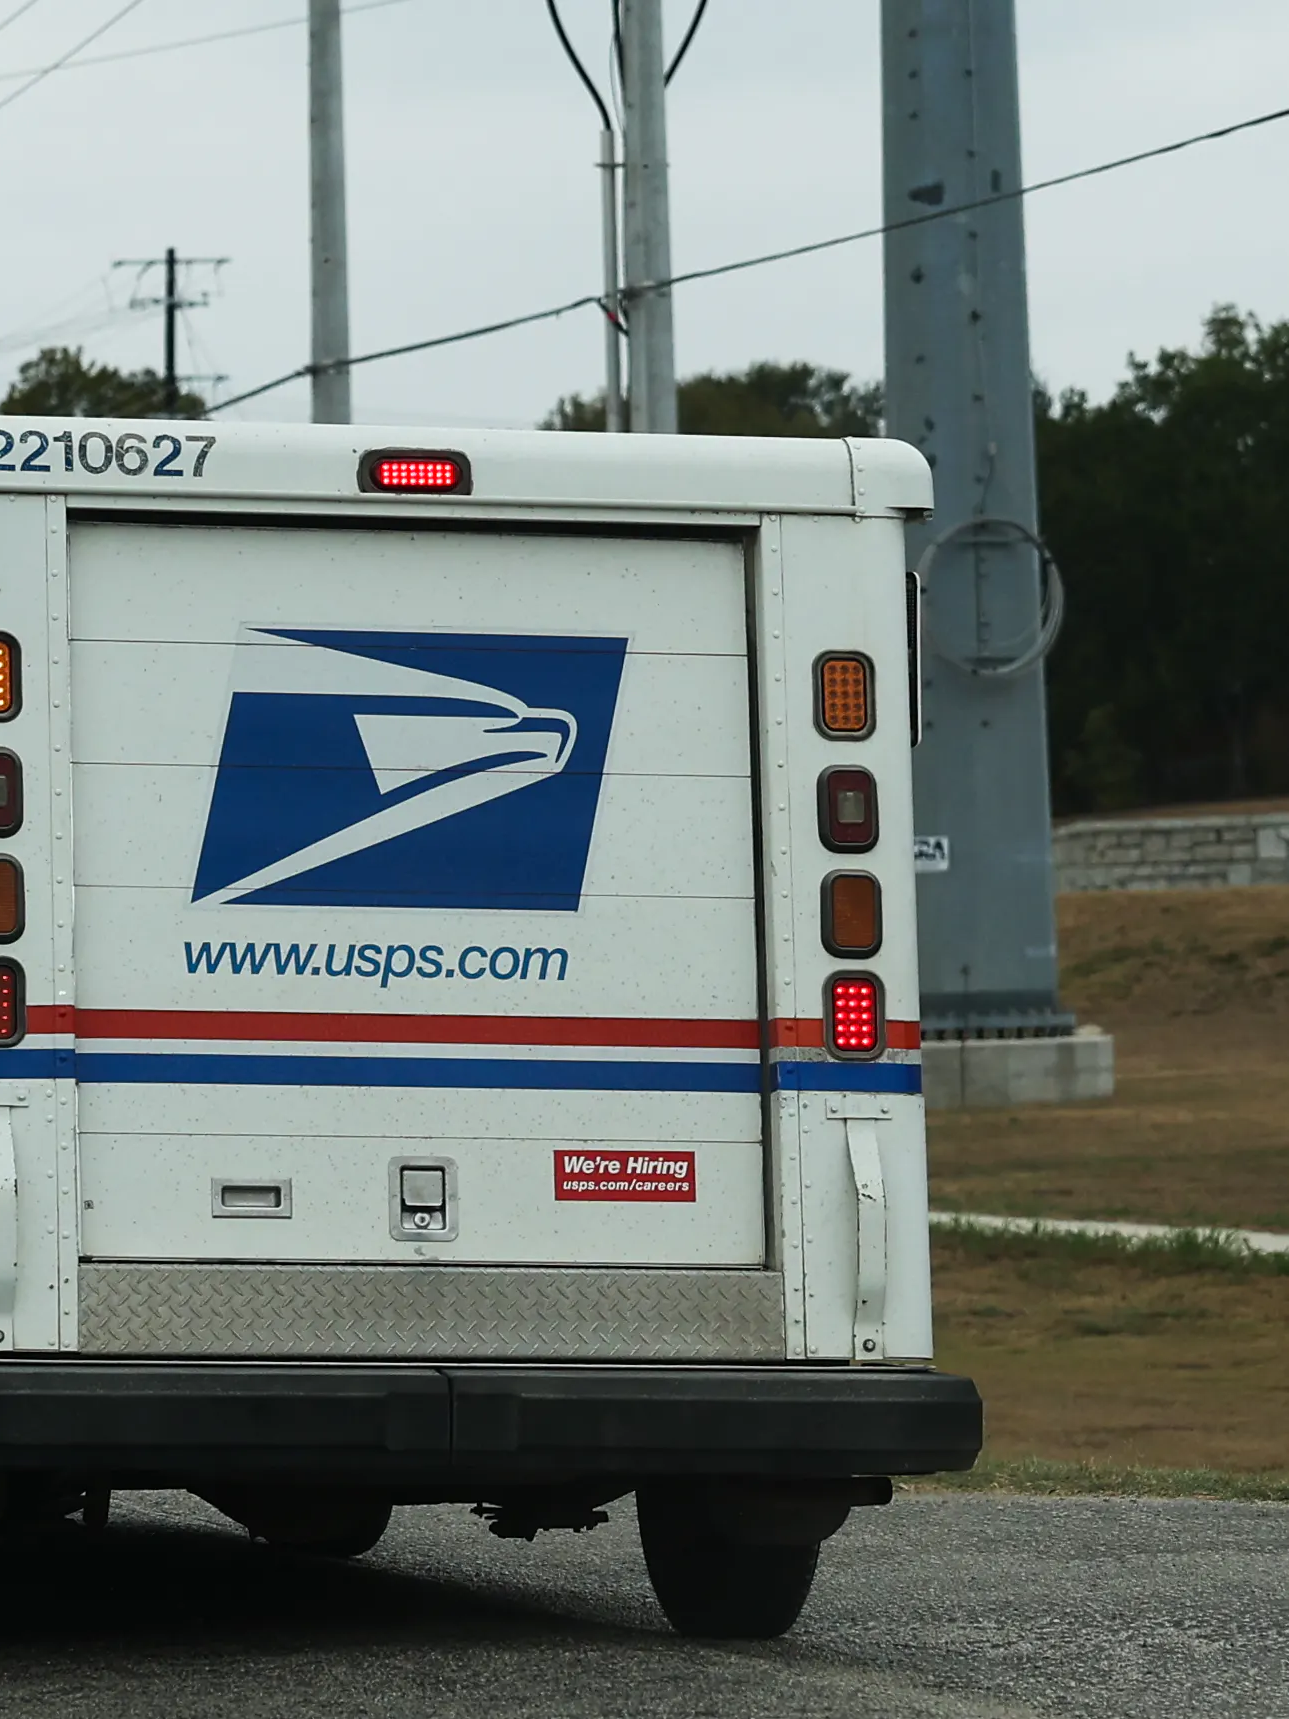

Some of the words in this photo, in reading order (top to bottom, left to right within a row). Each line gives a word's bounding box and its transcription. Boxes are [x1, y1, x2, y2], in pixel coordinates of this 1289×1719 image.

[184, 941, 569, 988] www.usps.com
[563, 1156, 621, 1174] We're
[626, 1156, 688, 1178] Hiring
[563, 1178, 690, 1193] usps.com/careers
